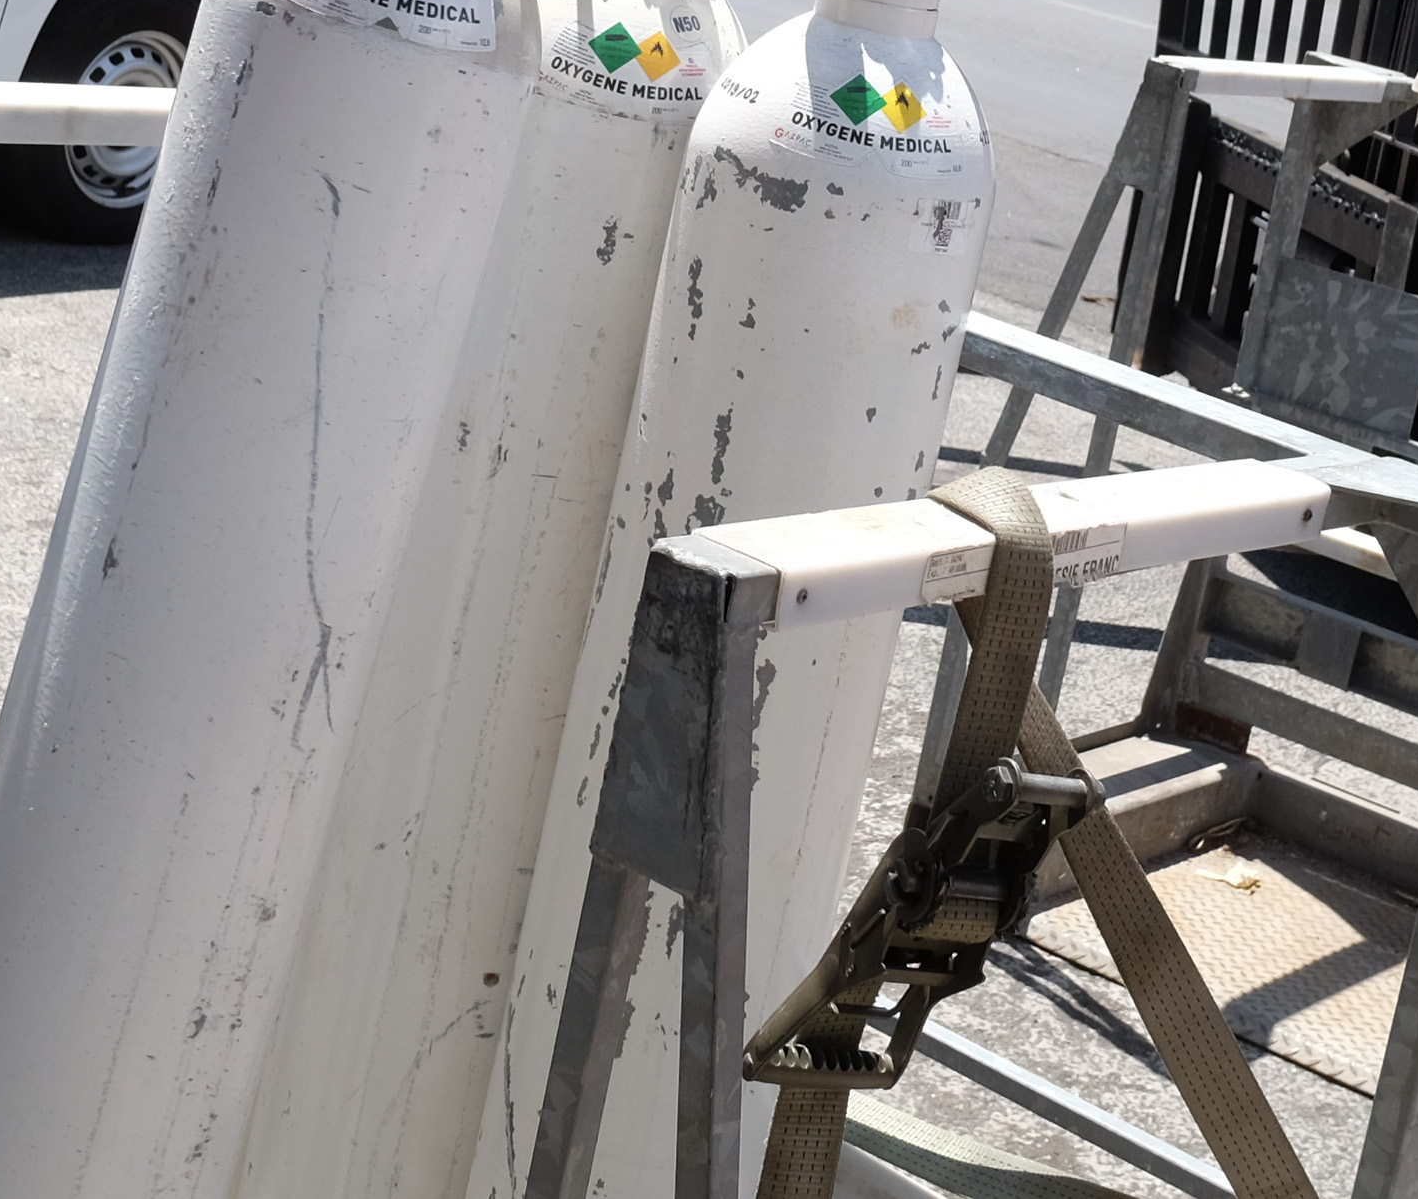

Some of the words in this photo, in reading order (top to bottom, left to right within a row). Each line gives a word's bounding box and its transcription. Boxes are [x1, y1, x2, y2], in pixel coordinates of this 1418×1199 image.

[672, 14, 702, 34] N50
[550, 55, 628, 95] OXYGENE
[632, 83, 703, 101] MEDICAL
[774, 126, 813, 148] GAZPAC
[791, 110, 874, 148] OXYGENE
[879, 135, 952, 154] MEDICAL
